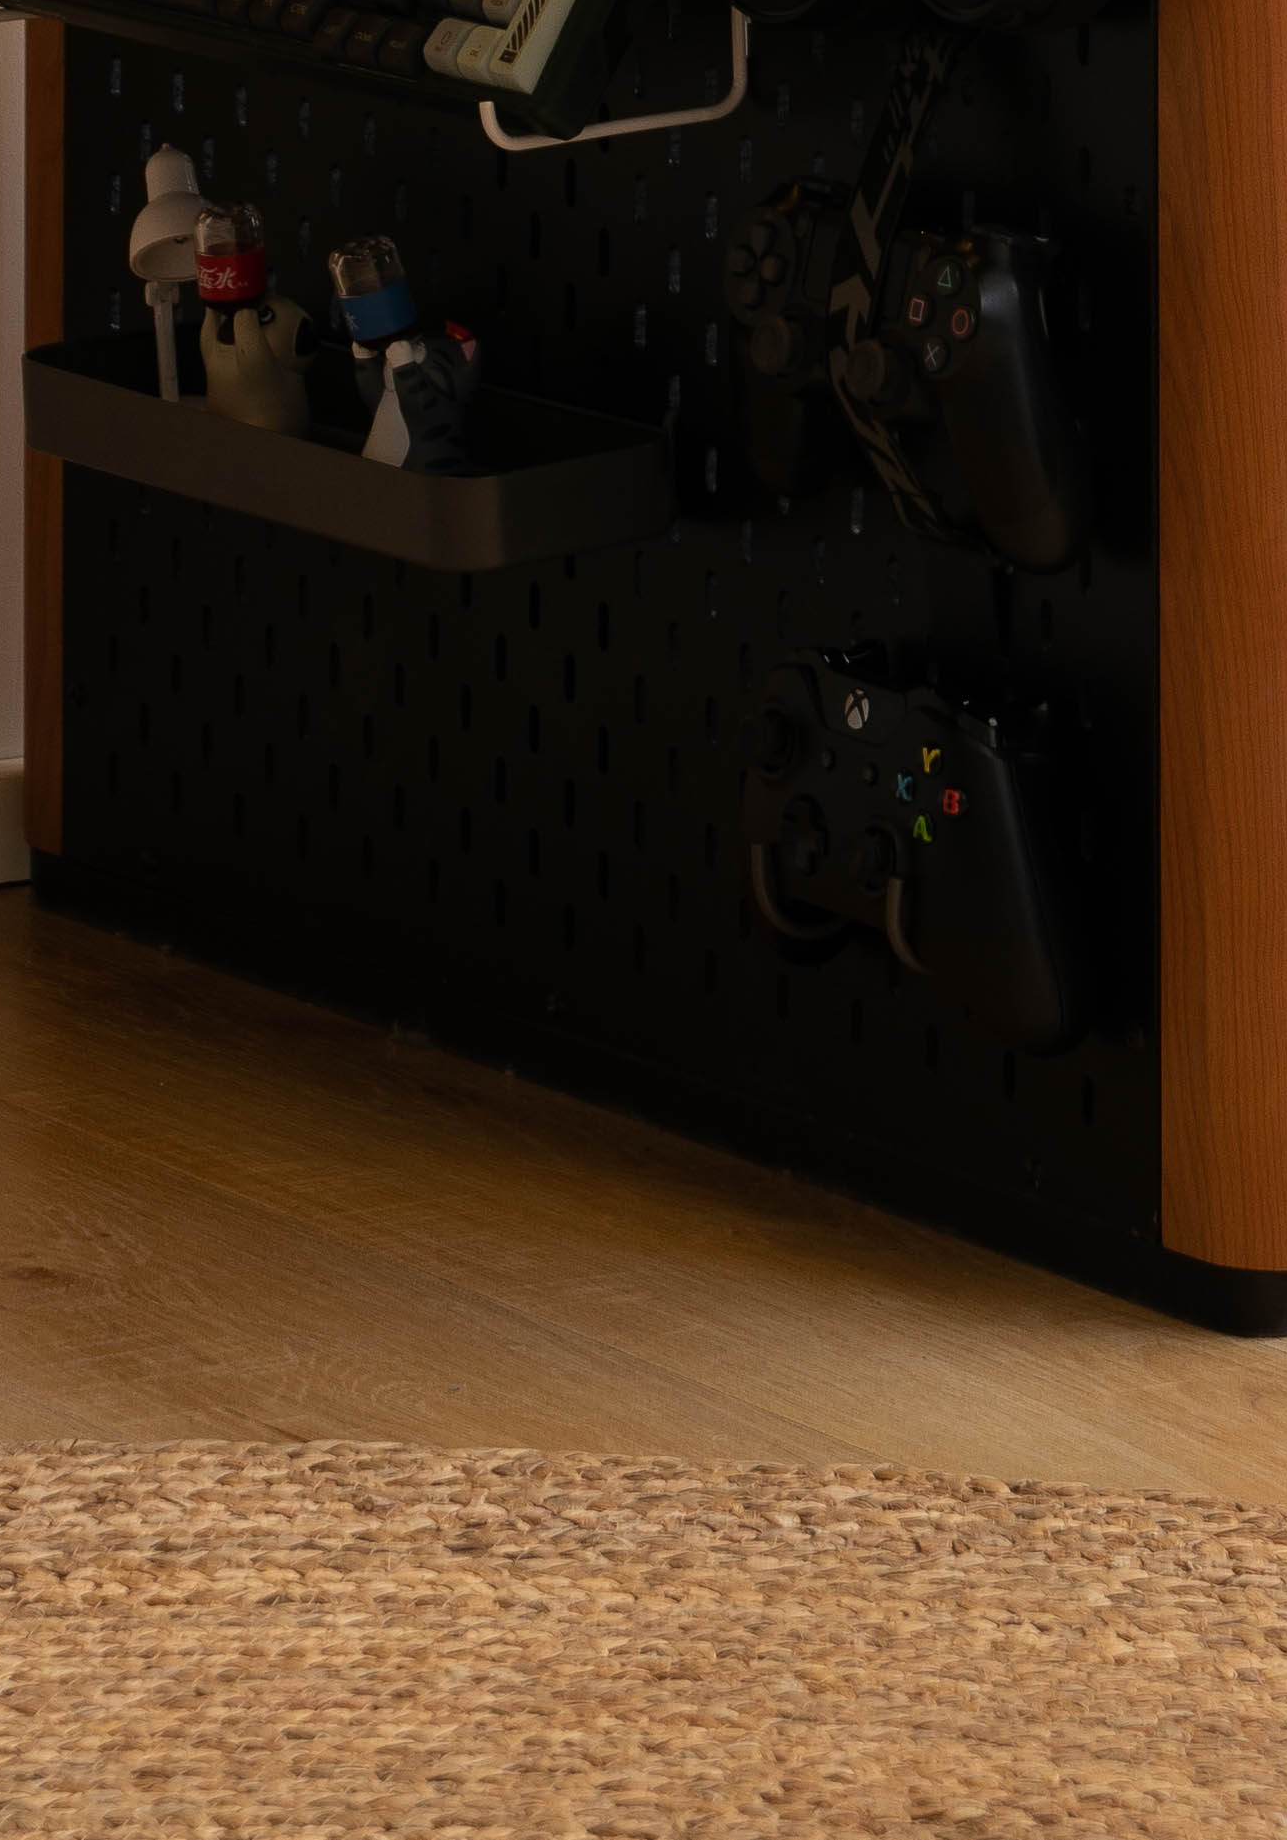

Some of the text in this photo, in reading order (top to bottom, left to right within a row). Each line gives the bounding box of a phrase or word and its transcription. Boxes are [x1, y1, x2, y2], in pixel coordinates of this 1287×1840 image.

[921, 746, 941, 774] Y
[942, 788, 961, 815] B
[913, 814, 933, 843] A
